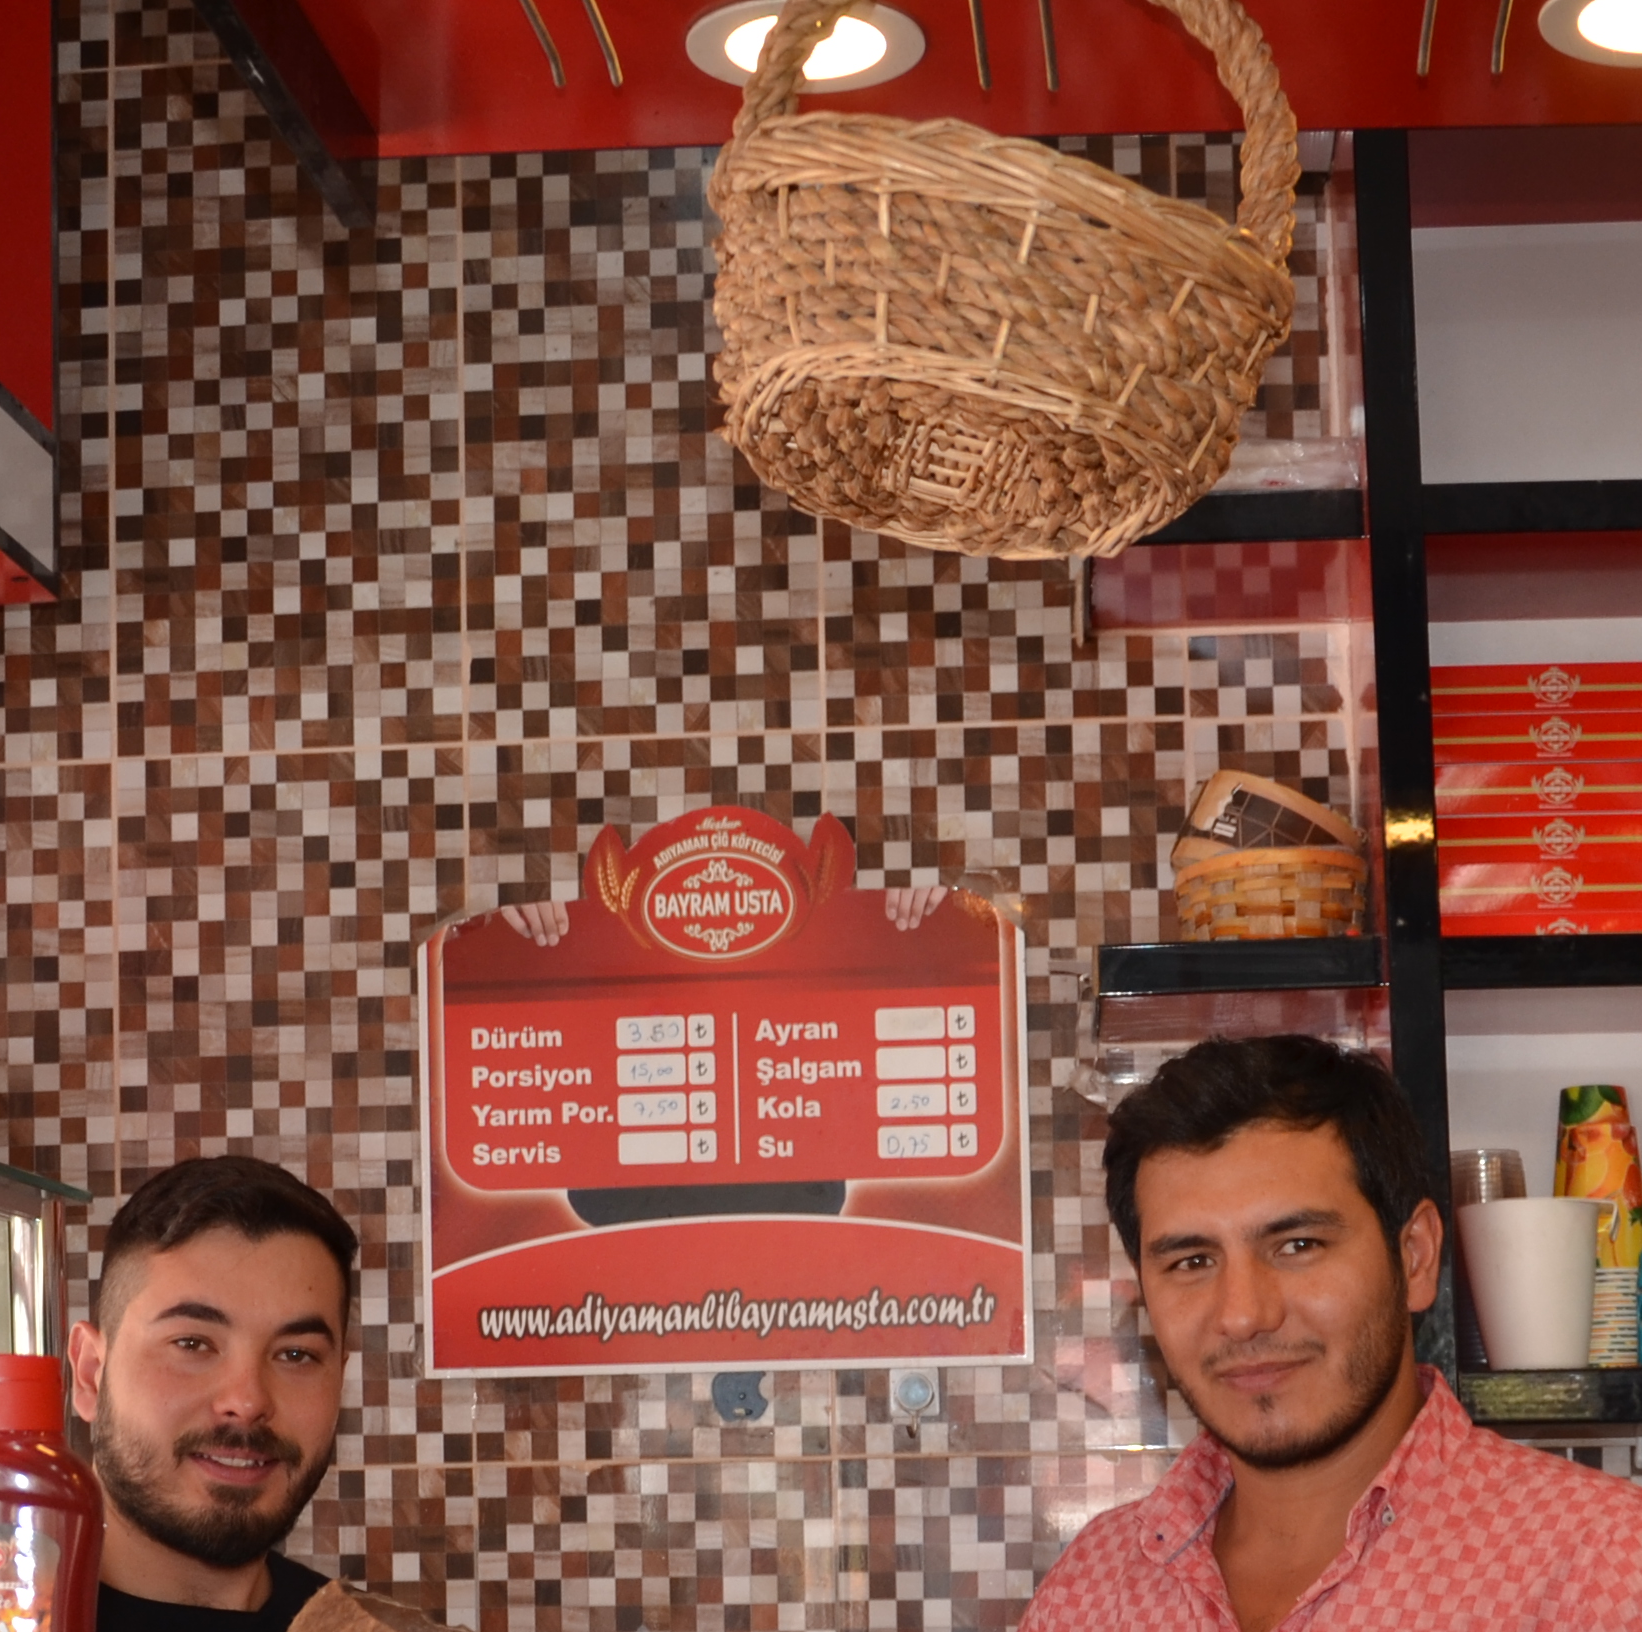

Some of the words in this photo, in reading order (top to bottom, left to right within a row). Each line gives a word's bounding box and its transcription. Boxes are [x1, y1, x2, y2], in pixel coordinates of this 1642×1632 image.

[653, 834, 709, 870] ADIYAMAN
[711, 832, 729, 850] ÇİĞ
[731, 833, 785, 865] KÖFTECİSİ
[654, 891, 731, 918] BAYRAM
[734, 889, 783, 916] USTA
[471, 1026, 562, 1050] Dürüm
[755, 1019, 838, 1046] Ayran
[471, 1064, 592, 1092] Porsiyon
[756, 1056, 862, 1086] Şalgam
[472, 1105, 552, 1127] Yarım
[562, 1101, 614, 1124] Por.
[757, 1095, 821, 1119] Kola
[473, 1141, 561, 1165] Servis
[758, 1134, 794, 1158] Su
[479, 1286, 994, 1342] www.adiyamanlibayramusta.com.tr
